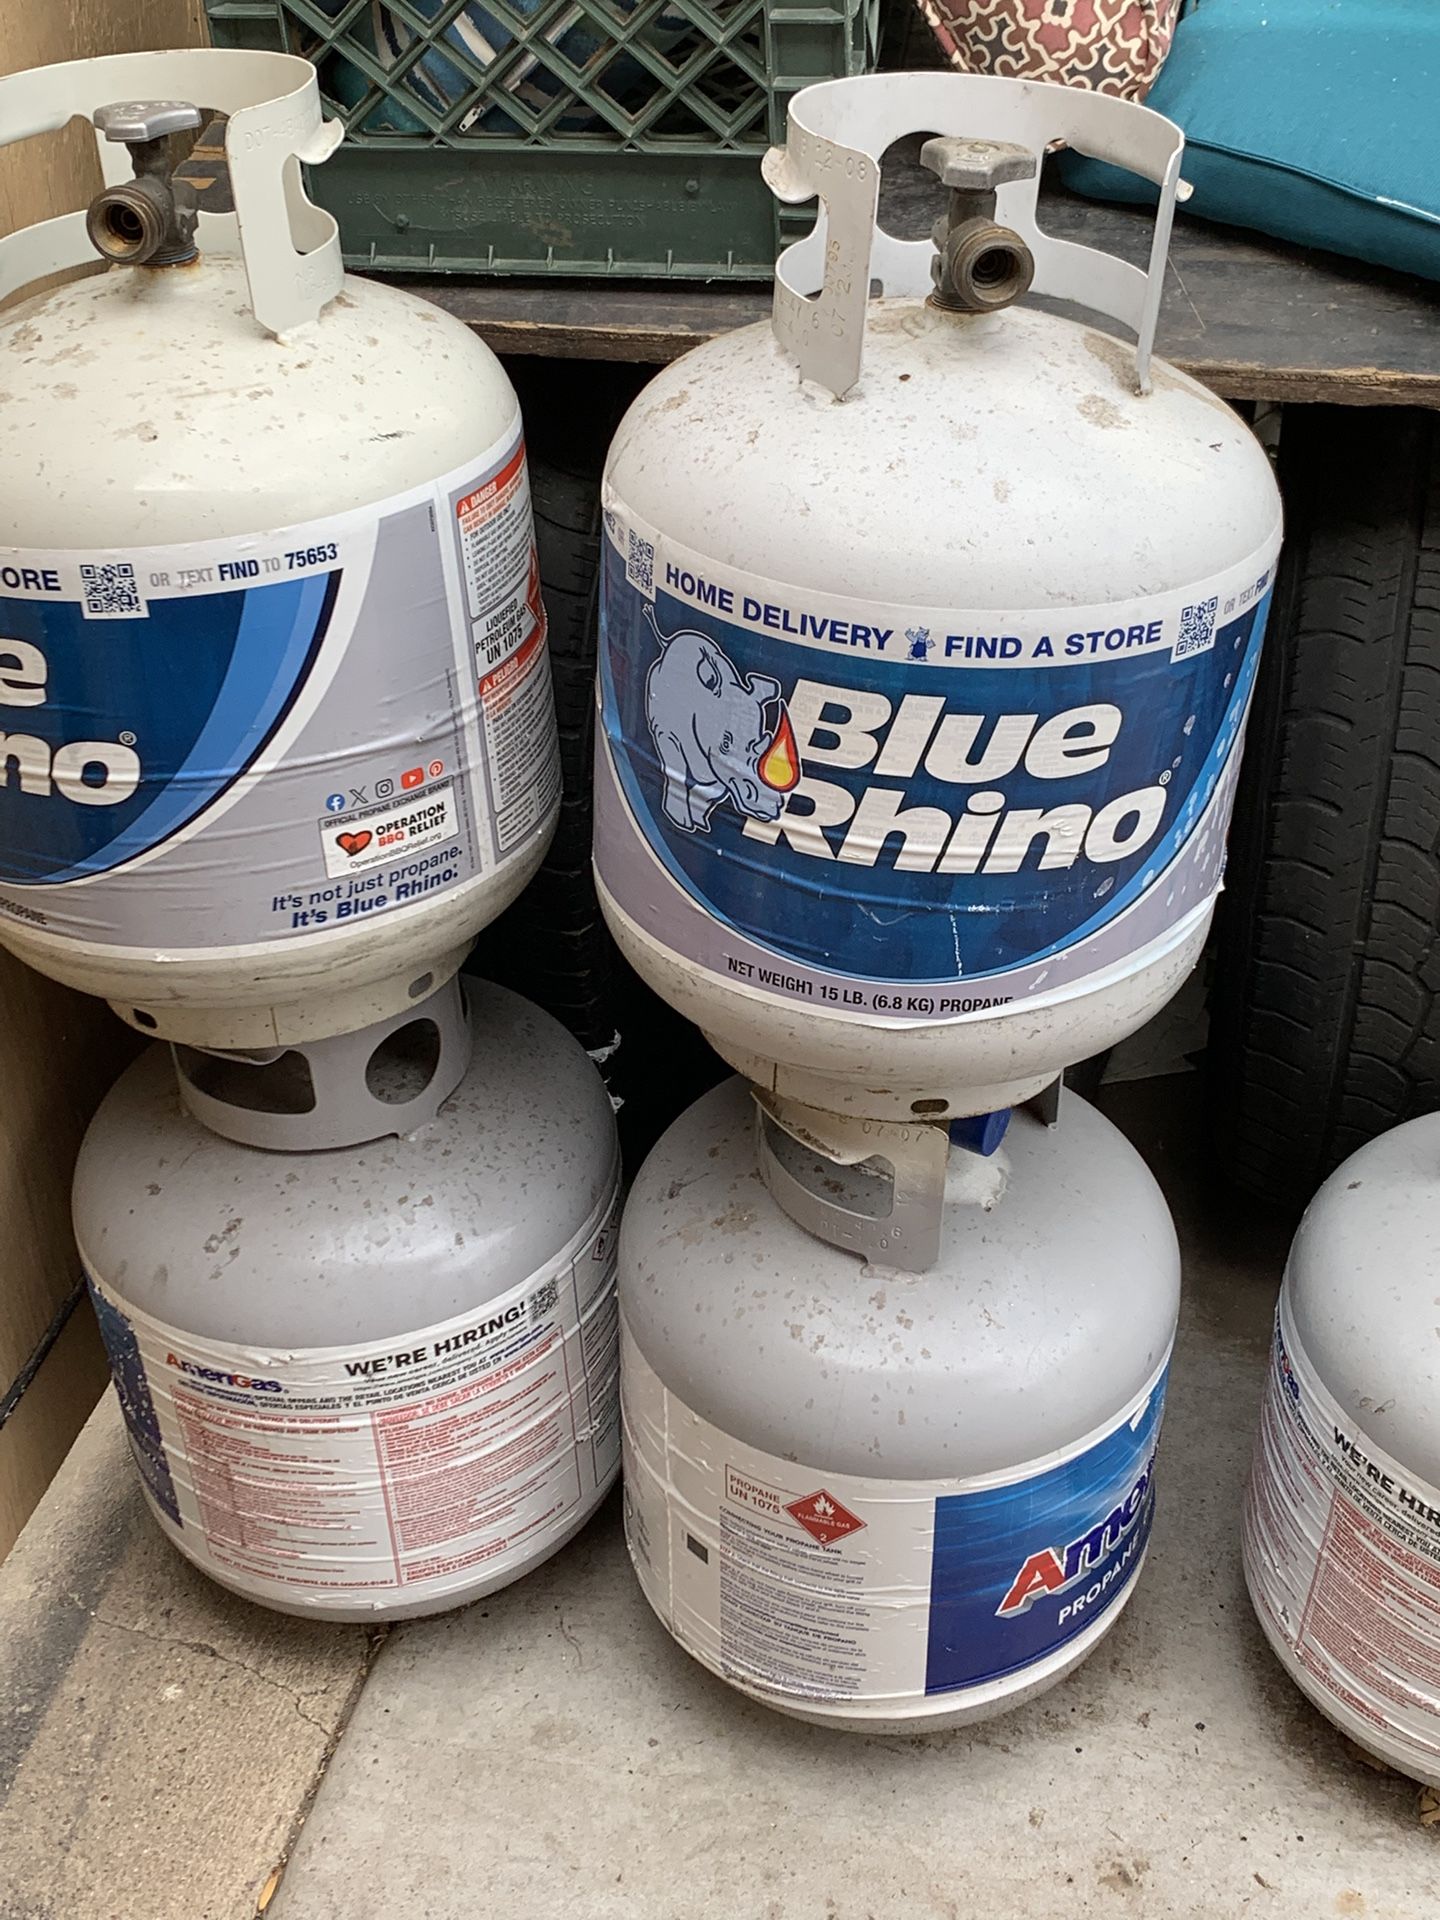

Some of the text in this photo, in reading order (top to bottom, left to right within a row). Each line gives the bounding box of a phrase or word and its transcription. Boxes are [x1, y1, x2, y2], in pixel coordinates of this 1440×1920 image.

[218, 560, 259, 581] FIND
[262, 558, 281, 573] TO
[284, 543, 337, 570] 75653
[665, 562, 735, 614] HOME
[742, 597, 895, 652] DELIVERY
[944, 633, 1022, 660] FIND
[1032, 633, 1056, 658] A
[1064, 621, 1163, 655] STORE
[475, 613, 517, 654] PETROLEUM
[487, 623, 523, 664] UN 1075
[791, 678, 1123, 784] Blue
[324, 780, 450, 829] OFFICIAL PROPANE EXCHANGE BRAND
[375, 801, 446, 837] OPERATION
[377, 812, 449, 847] BBQ RELIEF
[273, 845, 463, 912] It's not just propane.
[291, 908, 329, 929] It's
[336, 893, 389, 920] Blue
[728, 956, 756, 979] NET
[819, 985, 839, 1002] 15
[843, 989, 868, 1007] LB.
[871, 993, 903, 1011] (6.8
[907, 997, 935, 1015] KG)
[345, 1347, 428, 1377] WE'RE
[433, 1300, 528, 1358] HIRING!
[383, 1382, 426, 1396] LOCATIONS
[428, 1369, 460, 1387] NEAREST
[462, 1362, 477, 1374] YOU
[406, 1386, 430, 1398] VENTA
[1334, 1425, 1395, 1495] WE'RE
[730, 1474, 780, 1504] PROPANE
[730, 1485, 781, 1515] UN 1075
[797, 1512, 851, 1530] FLAMMABLE GAS
[820, 1533, 827, 1543] 2
[1362, 1503, 1383, 1526] VENTA
[1383, 1520, 1407, 1542] CERCA
[1408, 1537, 1418, 1549] DE
[1383, 1511, 1415, 1538] NEAREST
[1415, 1532, 1431, 1549] YOU
[785, 1536, 820, 1551] PROPANE
[822, 1547, 843, 1556] TANK
